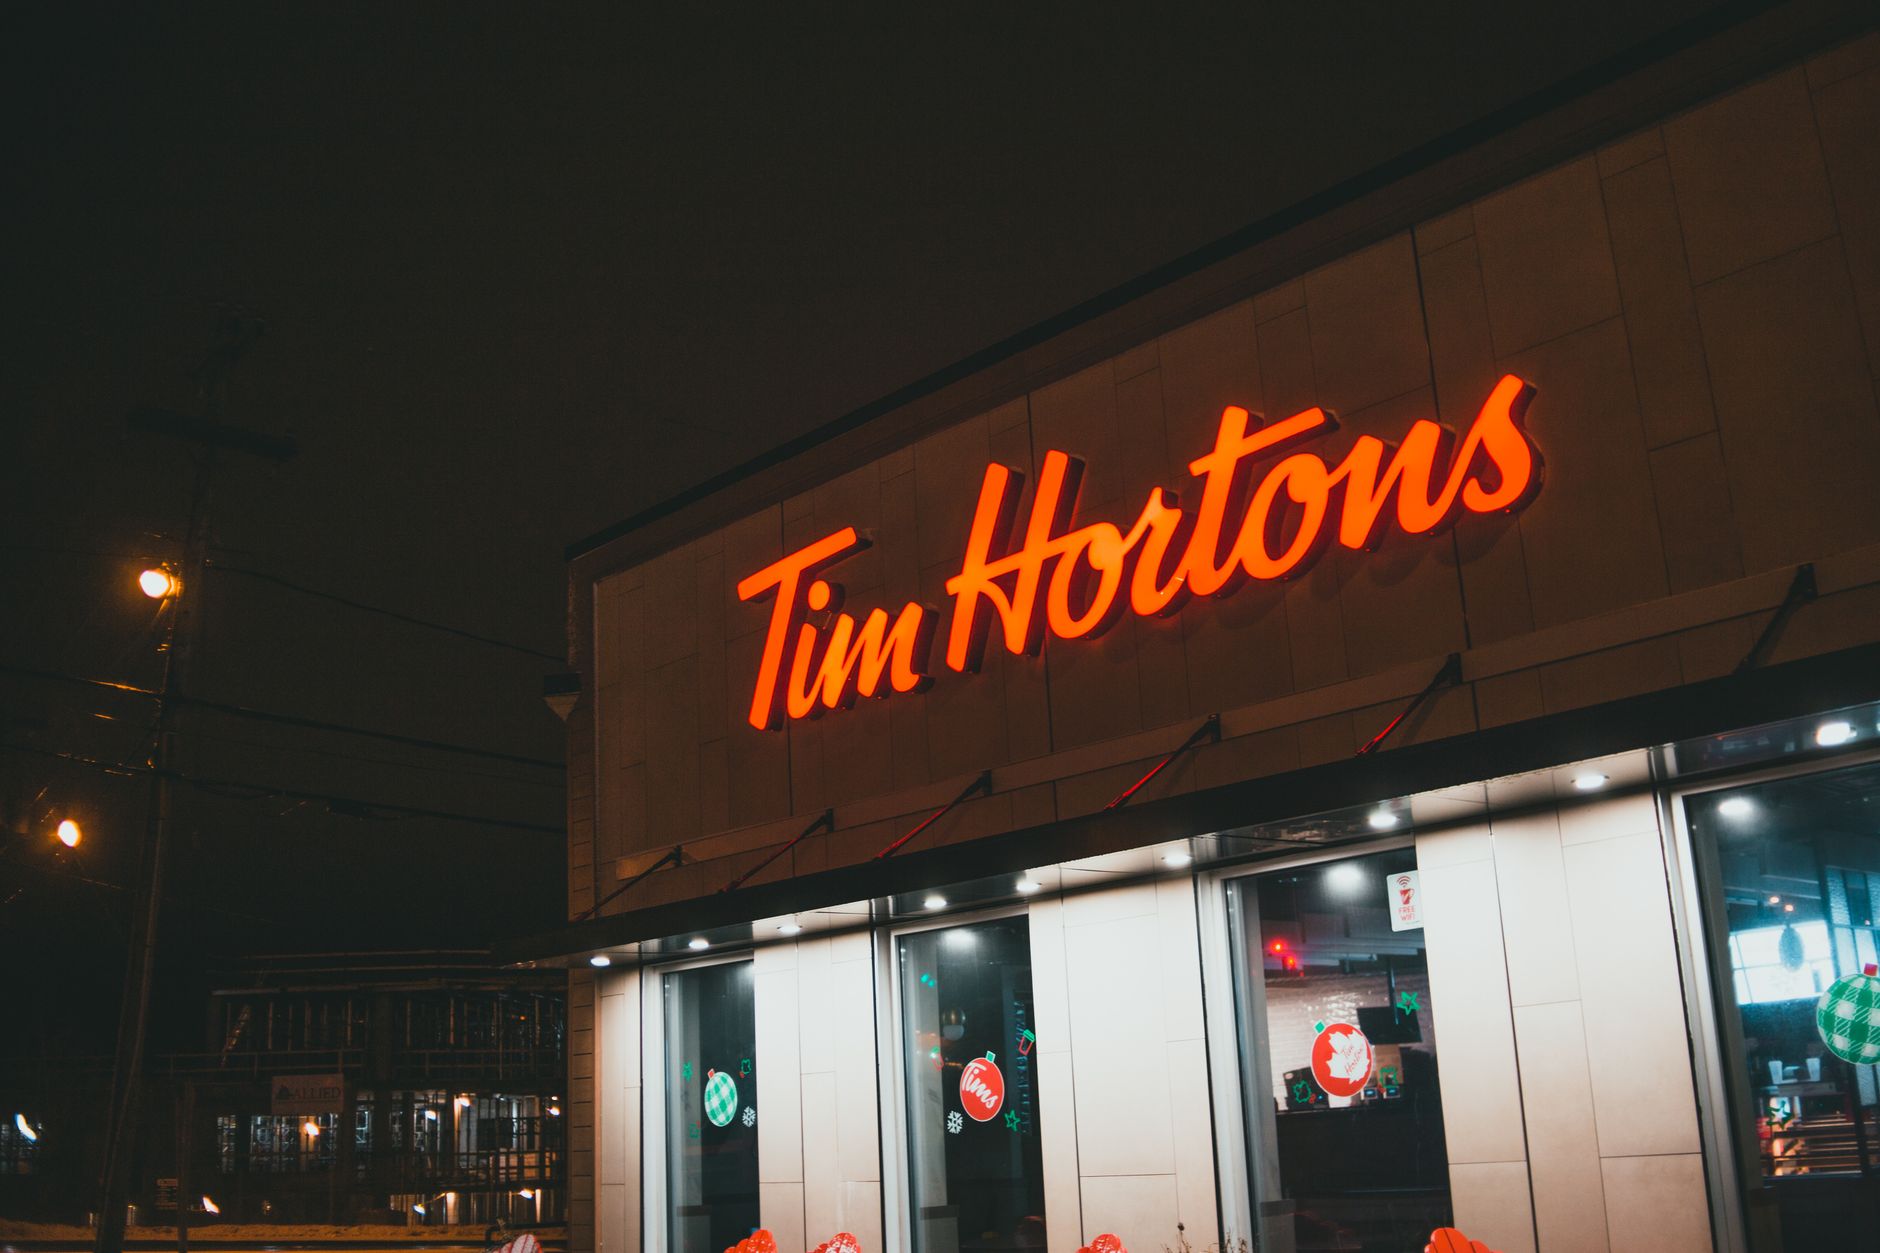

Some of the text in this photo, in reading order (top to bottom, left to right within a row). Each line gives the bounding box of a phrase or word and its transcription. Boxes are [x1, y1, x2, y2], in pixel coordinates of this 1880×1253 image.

[737, 373, 1533, 731] Tim Hortons
[1399, 905, 1415, 913] FREE
[293, 1086, 342, 1100] ALLIED
[962, 1062, 998, 1108] Tims
